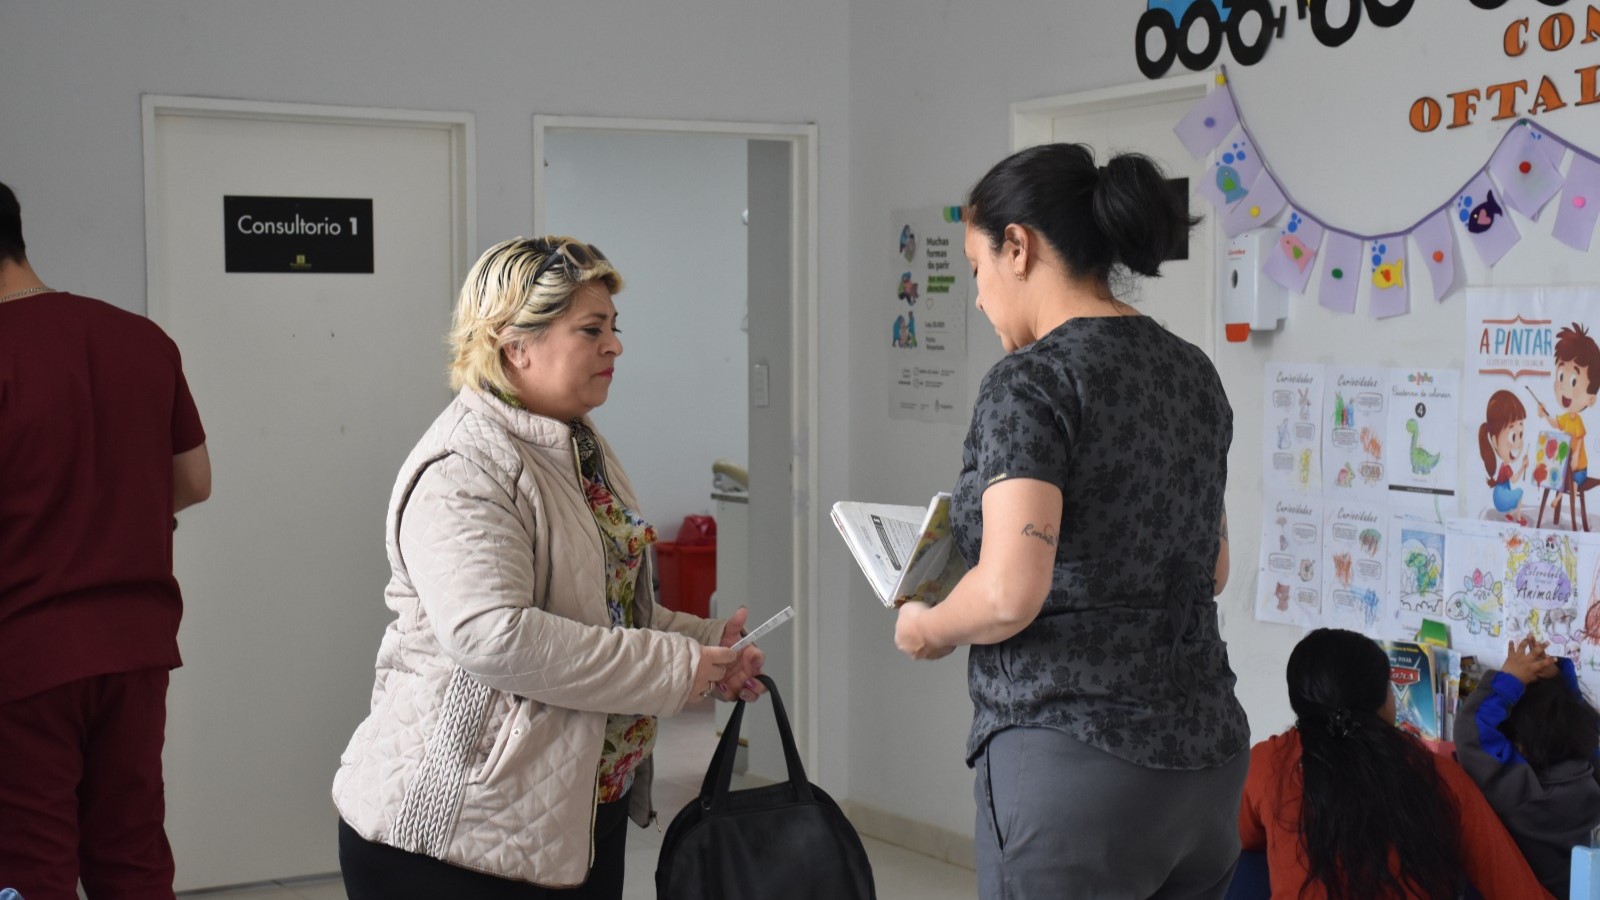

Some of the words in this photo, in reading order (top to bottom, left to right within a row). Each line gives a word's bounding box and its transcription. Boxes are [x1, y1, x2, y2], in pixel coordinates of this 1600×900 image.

[237, 213, 341, 236] Consultorio
[349, 216, 358, 236] 1
[926, 237, 949, 246] Muchas
[926, 249, 947, 258] formas
[928, 261, 935, 270] de
[936, 261, 950, 272] parir
[1480, 328, 1490, 355] A
[1495, 328, 1552, 355] PINTAR
[1276, 371, 1314, 384] Curiosidades
[1337, 374, 1378, 388] Curiosidades
[1416, 404, 1425, 416] 4
[1276, 501, 1313, 516] Curiosidades
[1337, 507, 1379, 523] Curiosidades
[1516, 580, 1572, 603] Animales
